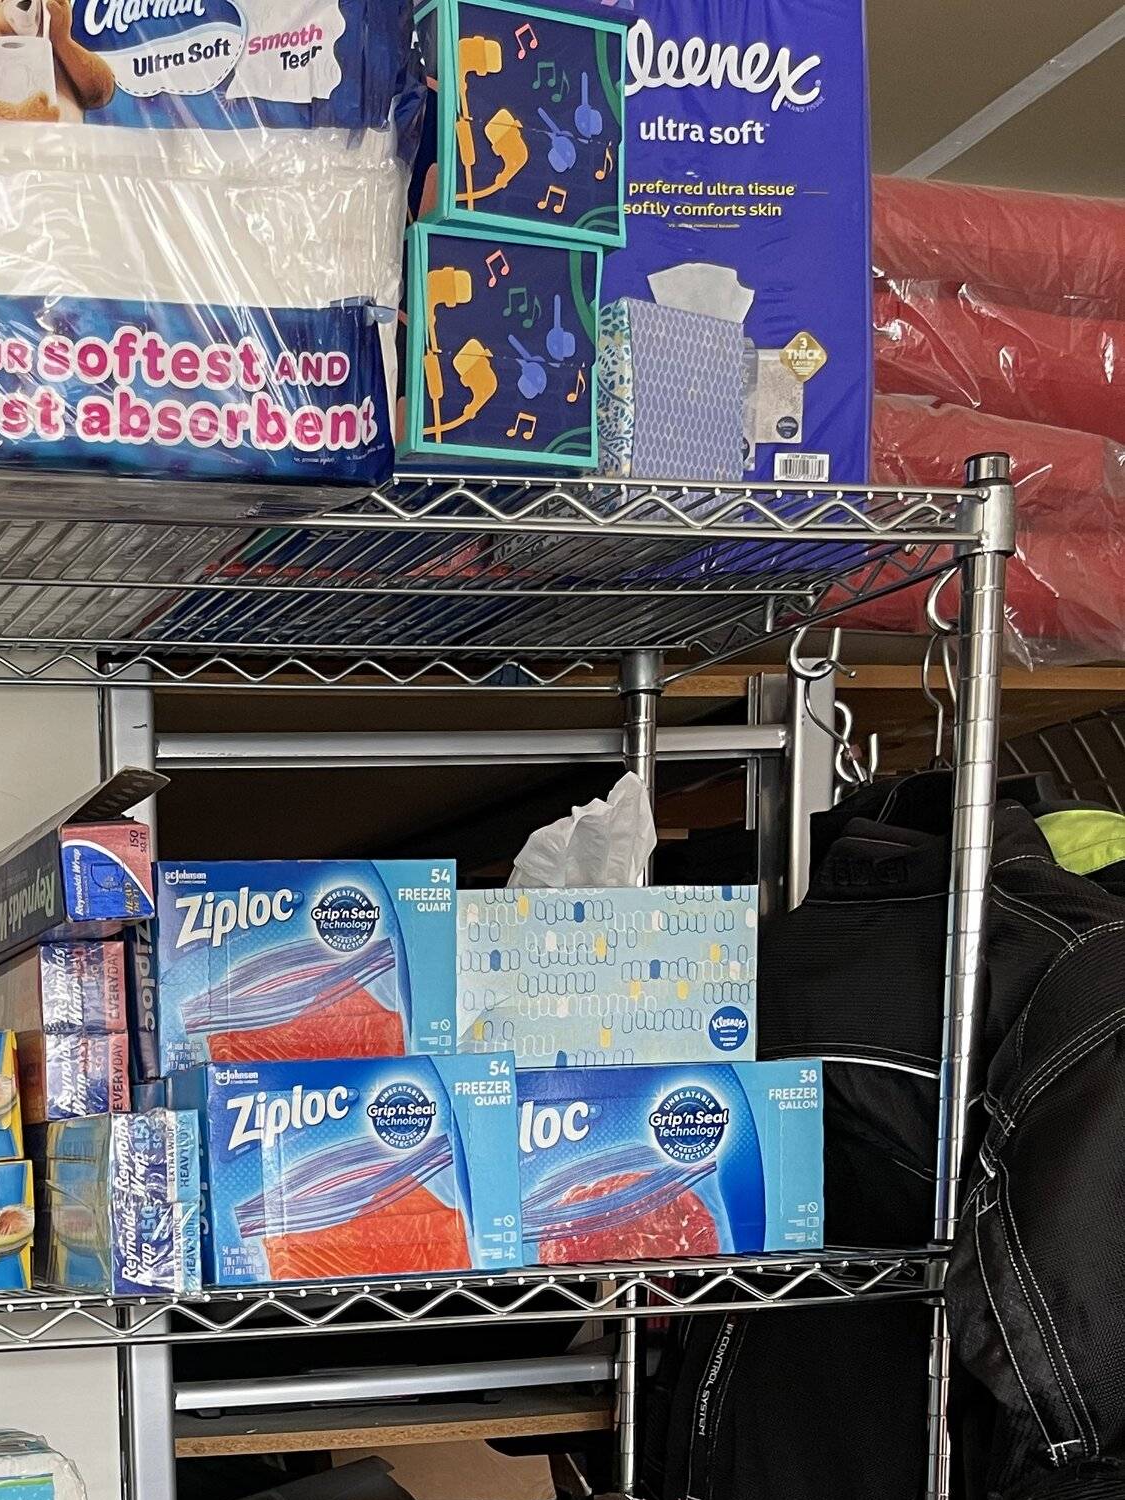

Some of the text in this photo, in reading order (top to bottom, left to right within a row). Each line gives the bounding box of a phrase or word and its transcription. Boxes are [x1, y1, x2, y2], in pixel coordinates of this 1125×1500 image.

[248, 25, 323, 55] Smooth
[132, 38, 232, 77] Ultra Soft
[280, 44, 323, 71] Tear
[625, 19, 820, 111] leenex
[640, 116, 765, 145] ultra soft
[629, 180, 795, 196] preferred ultra tissue
[623, 202, 782, 217] softly comforts skin
[800, 337, 808, 349] 3
[41, 329, 263, 389] softest
[275, 352, 348, 384] AND
[786, 349, 821, 360] THICK
[78, 390, 375, 447] absorbent
[129, 829, 139, 848] 150
[431, 868, 451, 883] 54
[398, 888, 452, 902] FREEZER
[312, 906, 380, 922] Grip'n Seal
[416, 902, 452, 913] QUART
[176, 887, 294, 949] Ziploc
[319, 919, 374, 932] Technology
[107, 951, 121, 1021] EVERYDAY
[489, 1061, 510, 1076] 54
[799, 1070, 818, 1083] 38
[111, 1042, 125, 1112] EVERYDAY
[454, 1081, 512, 1095] FREEZER
[768, 1088, 818, 1101] FREEZER
[474, 1095, 512, 1106] QUART
[663, 1091, 715, 1110] UNBEATABLE
[778, 1100, 818, 1109] GALLON
[227, 1085, 349, 1151] Ziploc
[367, 1103, 436, 1118] Grip'n Seal
[649, 1109, 729, 1128] Grip'n Seal
[375, 1116, 430, 1128] Technology
[519, 1101, 590, 1153] loc
[658, 1124, 722, 1138] Technology
[663, 1140, 715, 1161] PROTECTION
[698, 1323, 734, 1436] IR CONTROL SYSTEM
